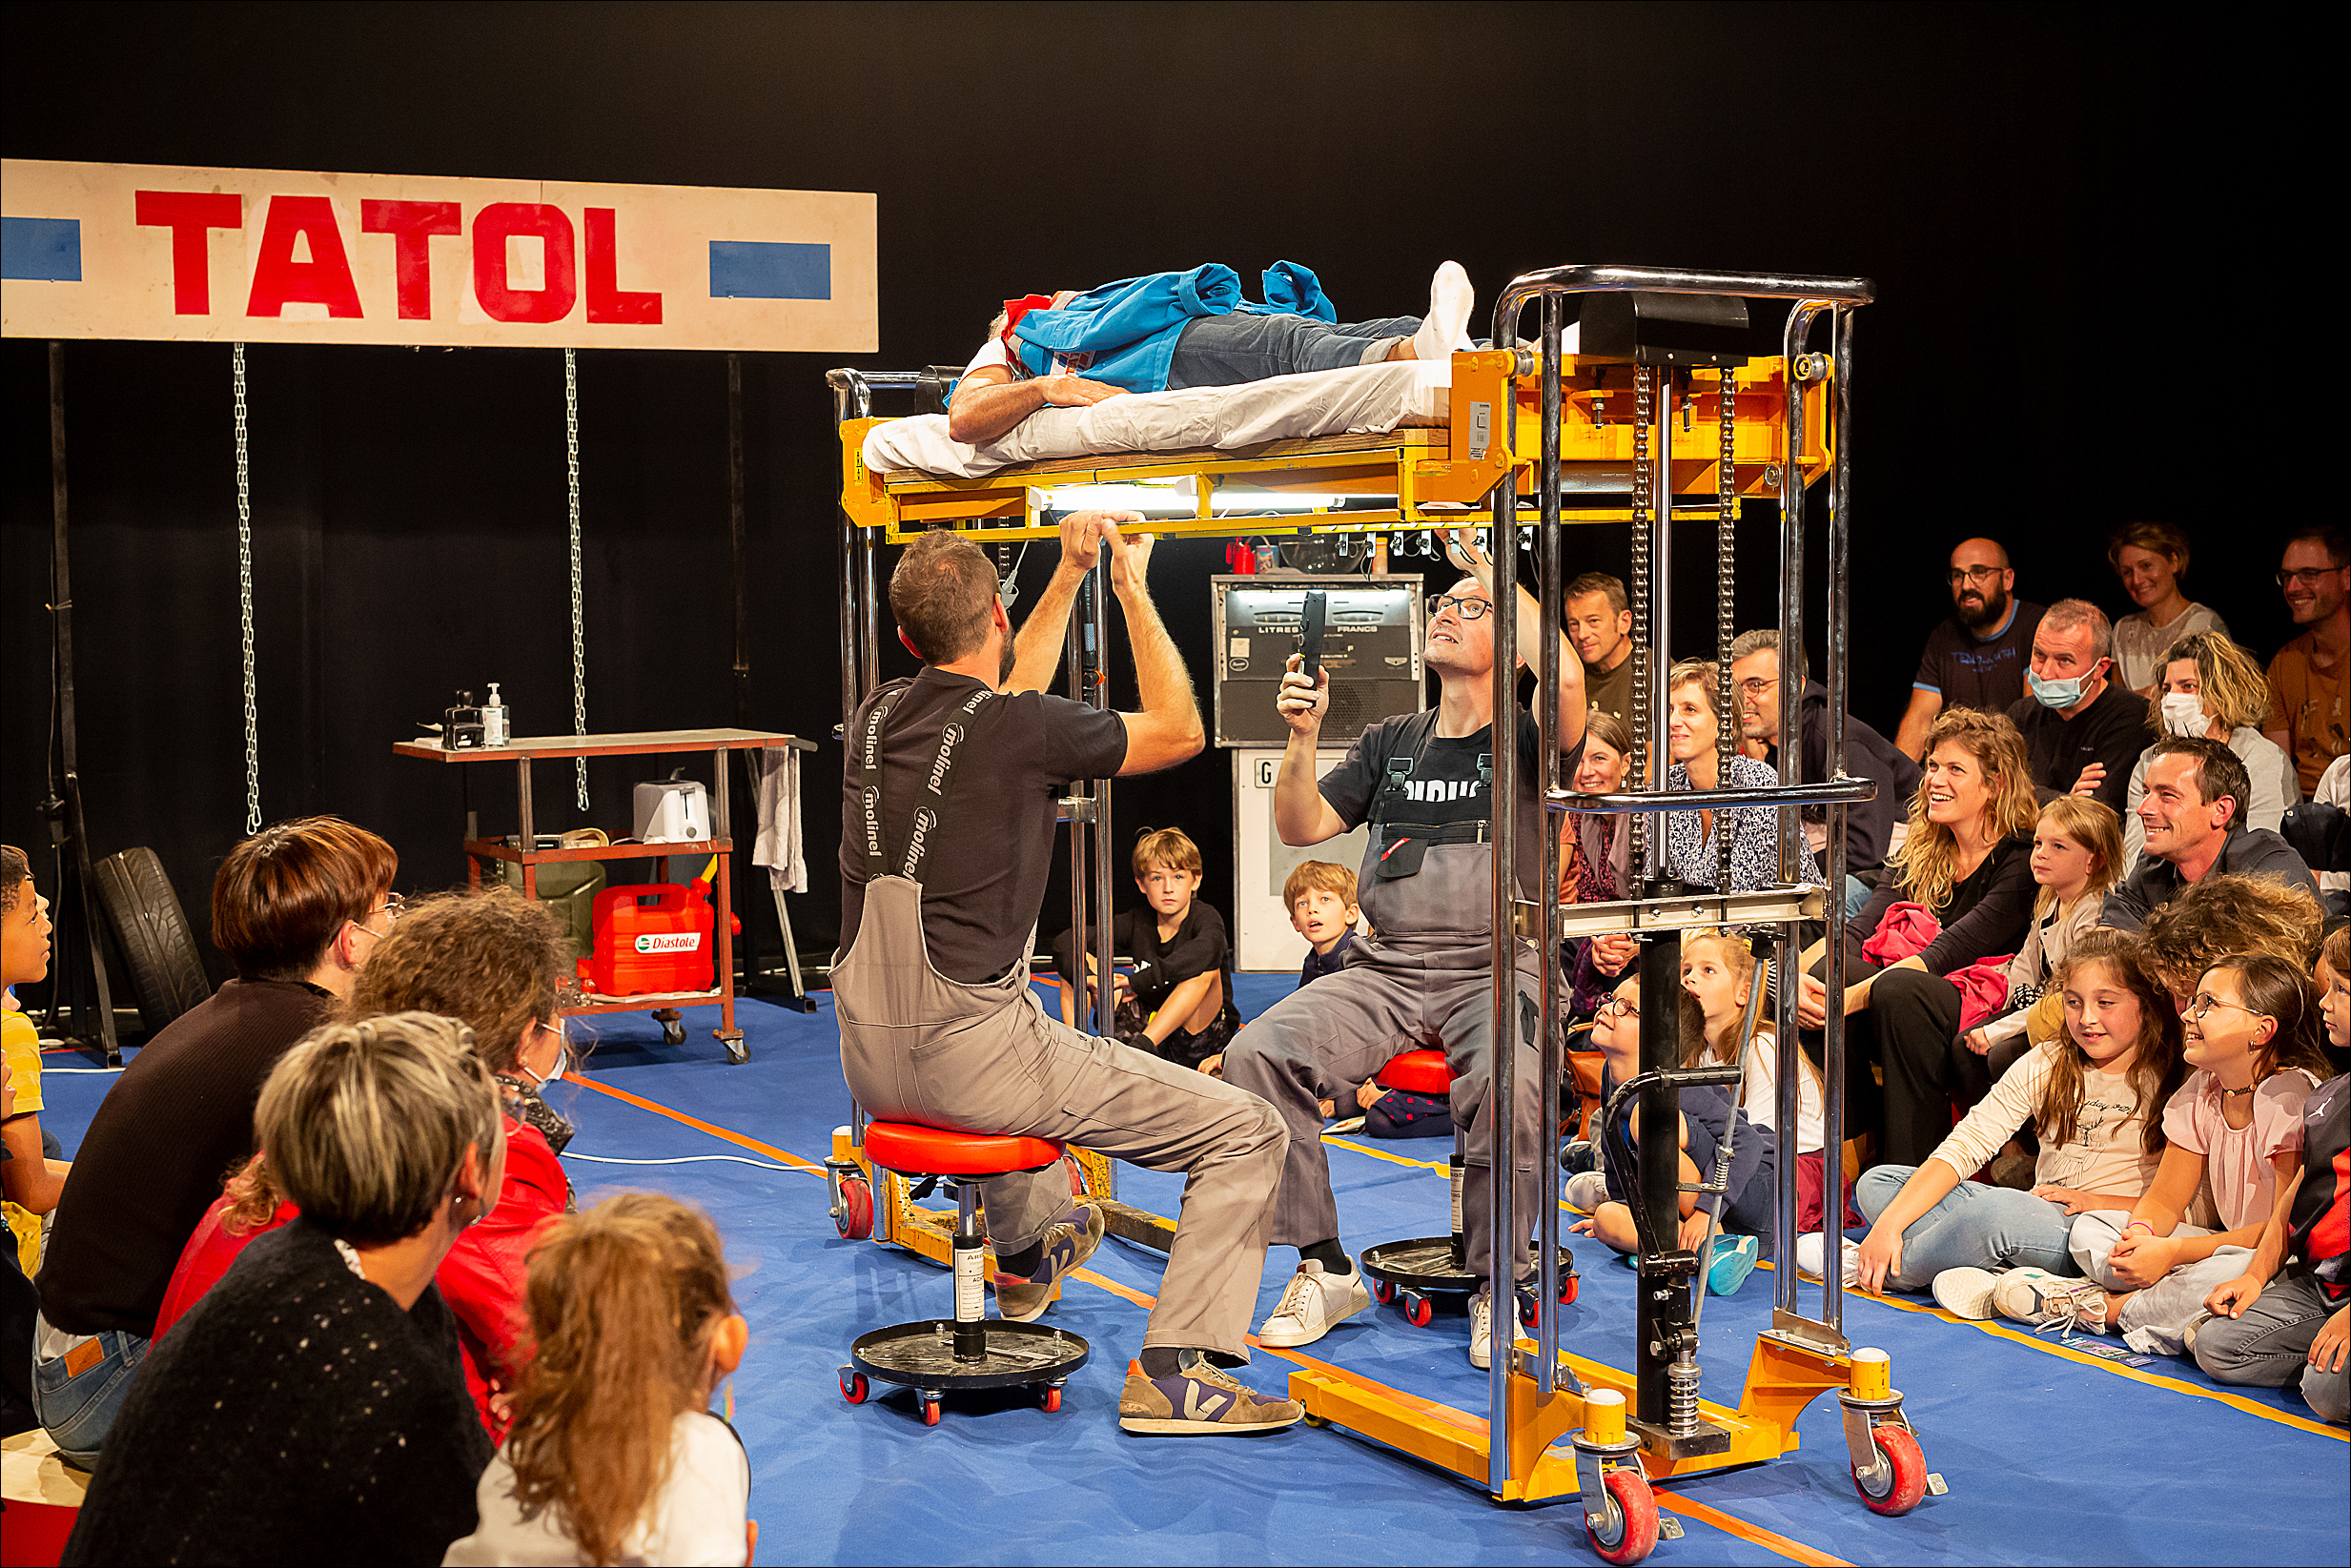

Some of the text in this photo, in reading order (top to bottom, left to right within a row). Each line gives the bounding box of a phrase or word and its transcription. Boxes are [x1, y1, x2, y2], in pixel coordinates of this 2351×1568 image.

[134, 190, 664, 325] TATOL
[865, 710, 882, 770] molinel
[928, 727, 957, 795] molinel
[865, 792, 883, 857] molinel
[652, 936, 695, 948] Diastole
